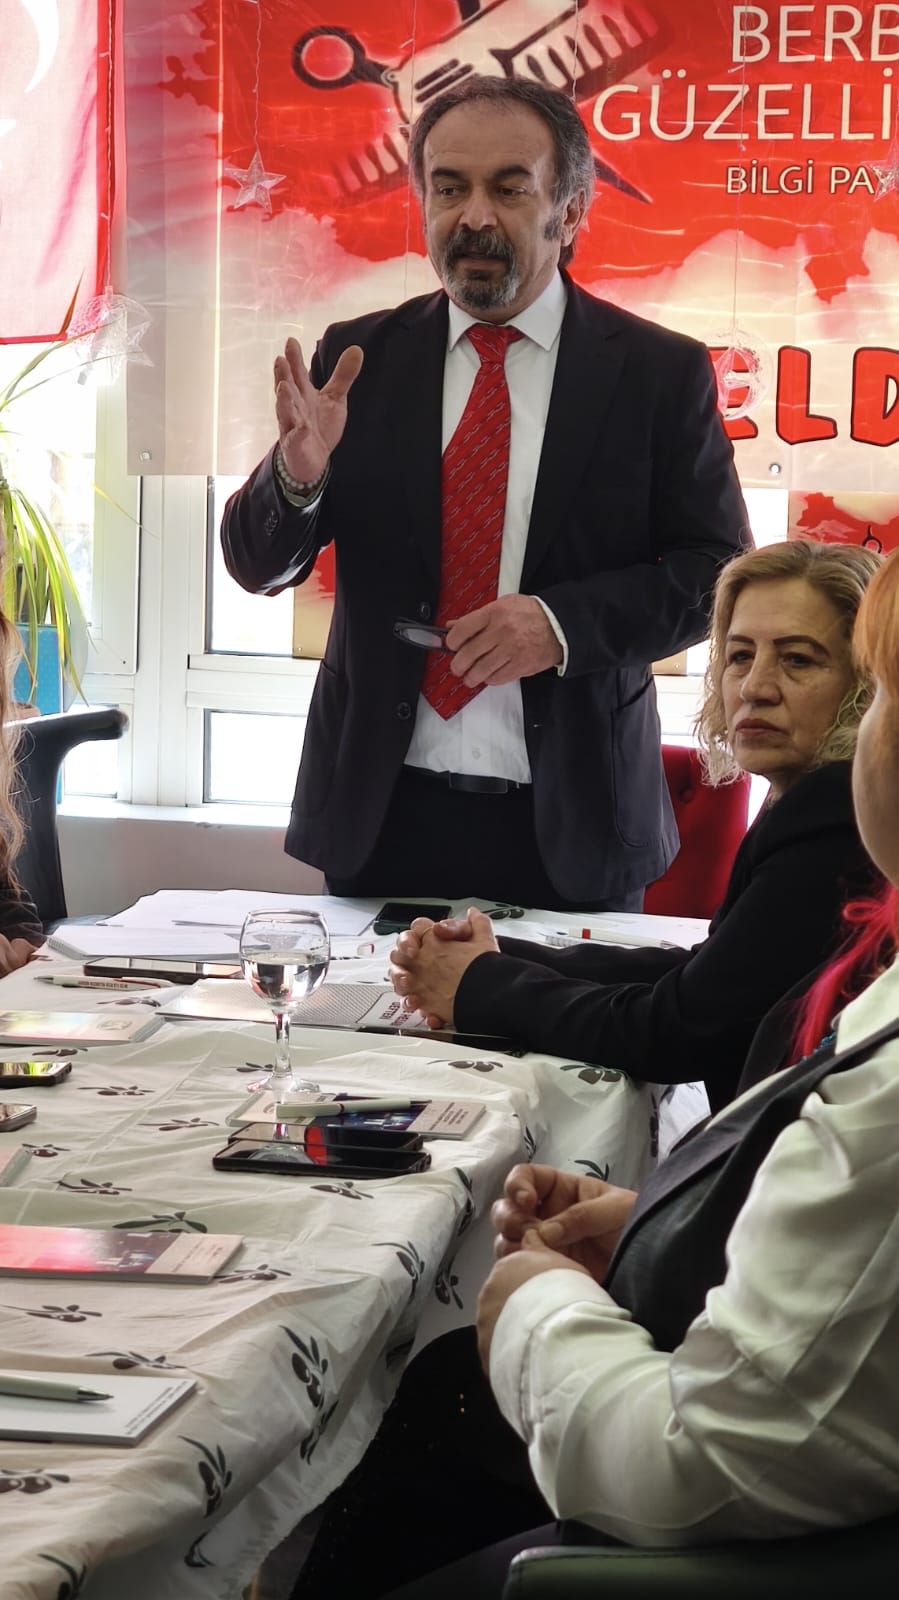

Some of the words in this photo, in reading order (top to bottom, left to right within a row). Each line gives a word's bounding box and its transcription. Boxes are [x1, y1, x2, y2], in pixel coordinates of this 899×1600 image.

[732, 4, 899, 63] BERB
[592, 69, 892, 141] GÜZELLİ
[727, 160, 813, 194] BİLGİ
